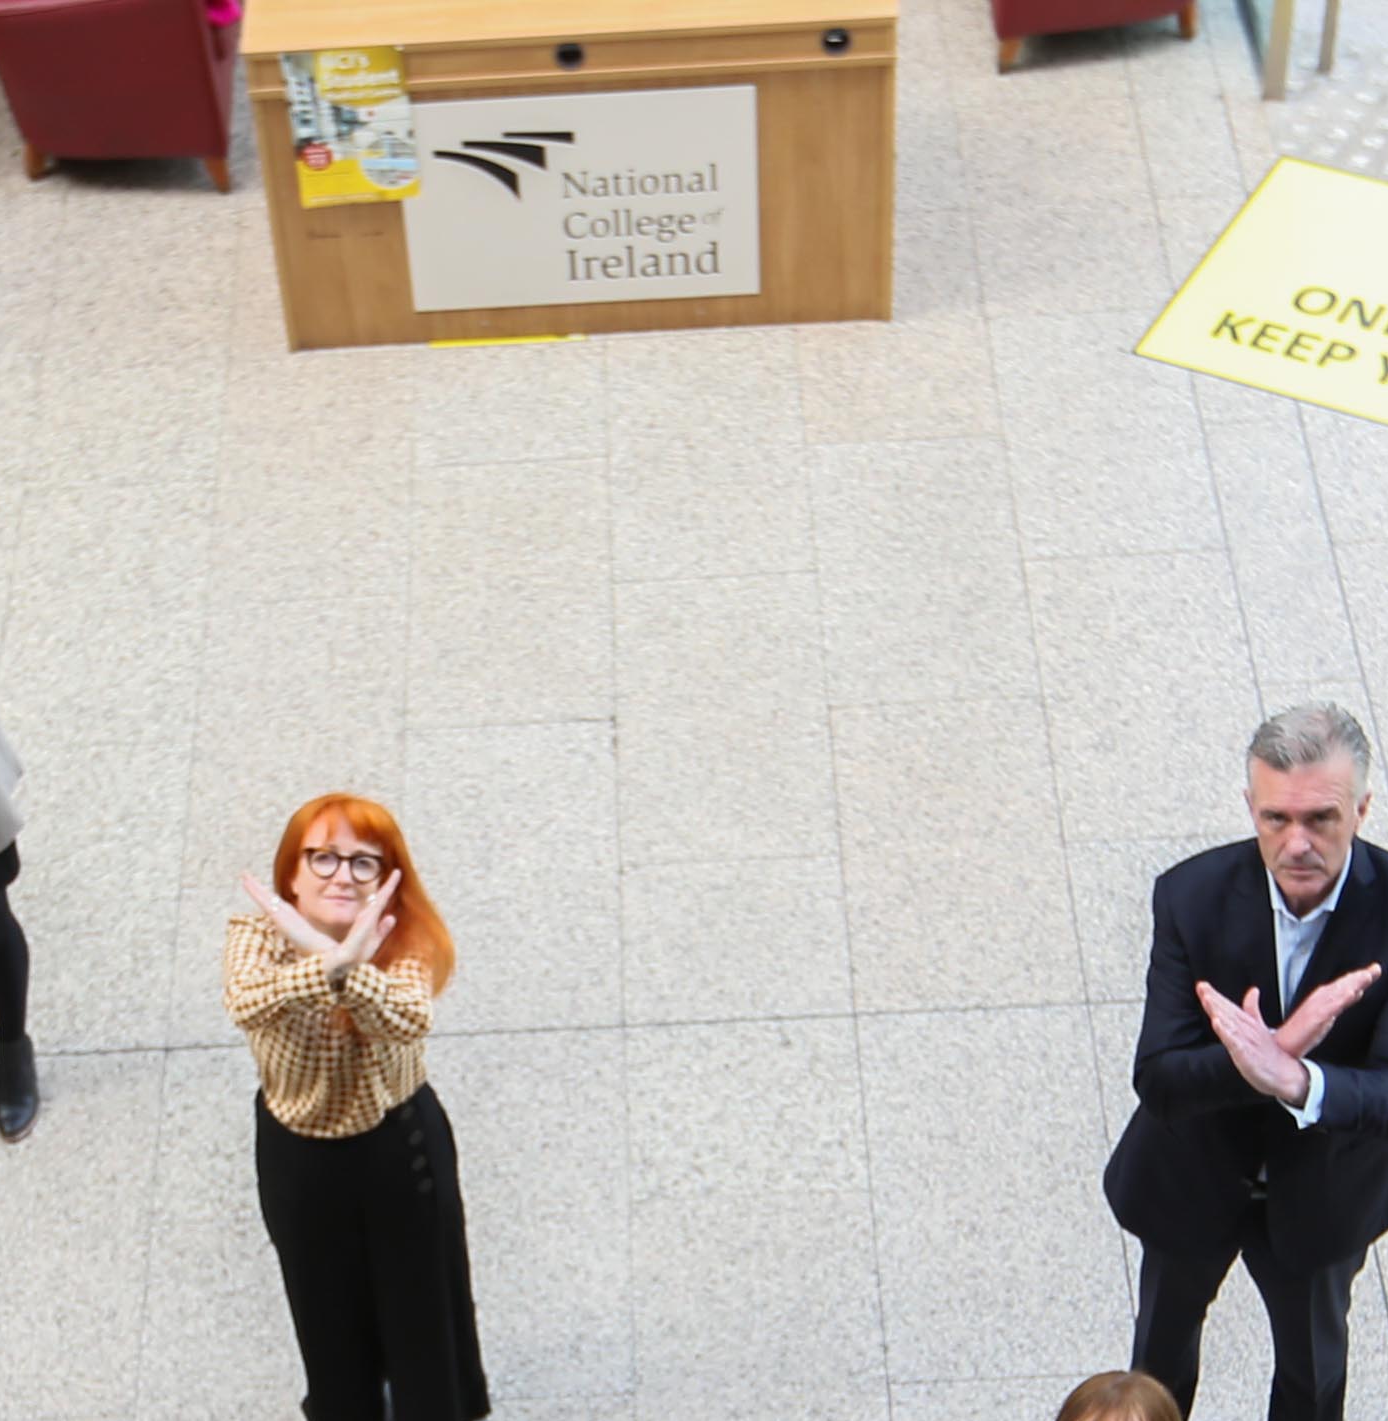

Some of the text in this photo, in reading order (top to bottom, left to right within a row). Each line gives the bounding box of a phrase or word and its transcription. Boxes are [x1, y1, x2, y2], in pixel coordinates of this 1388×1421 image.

[562, 163, 718, 199] National
[563, 208, 696, 243] College
[566, 240, 721, 281] Ireland
[1211, 311, 1359, 369] KEEP
